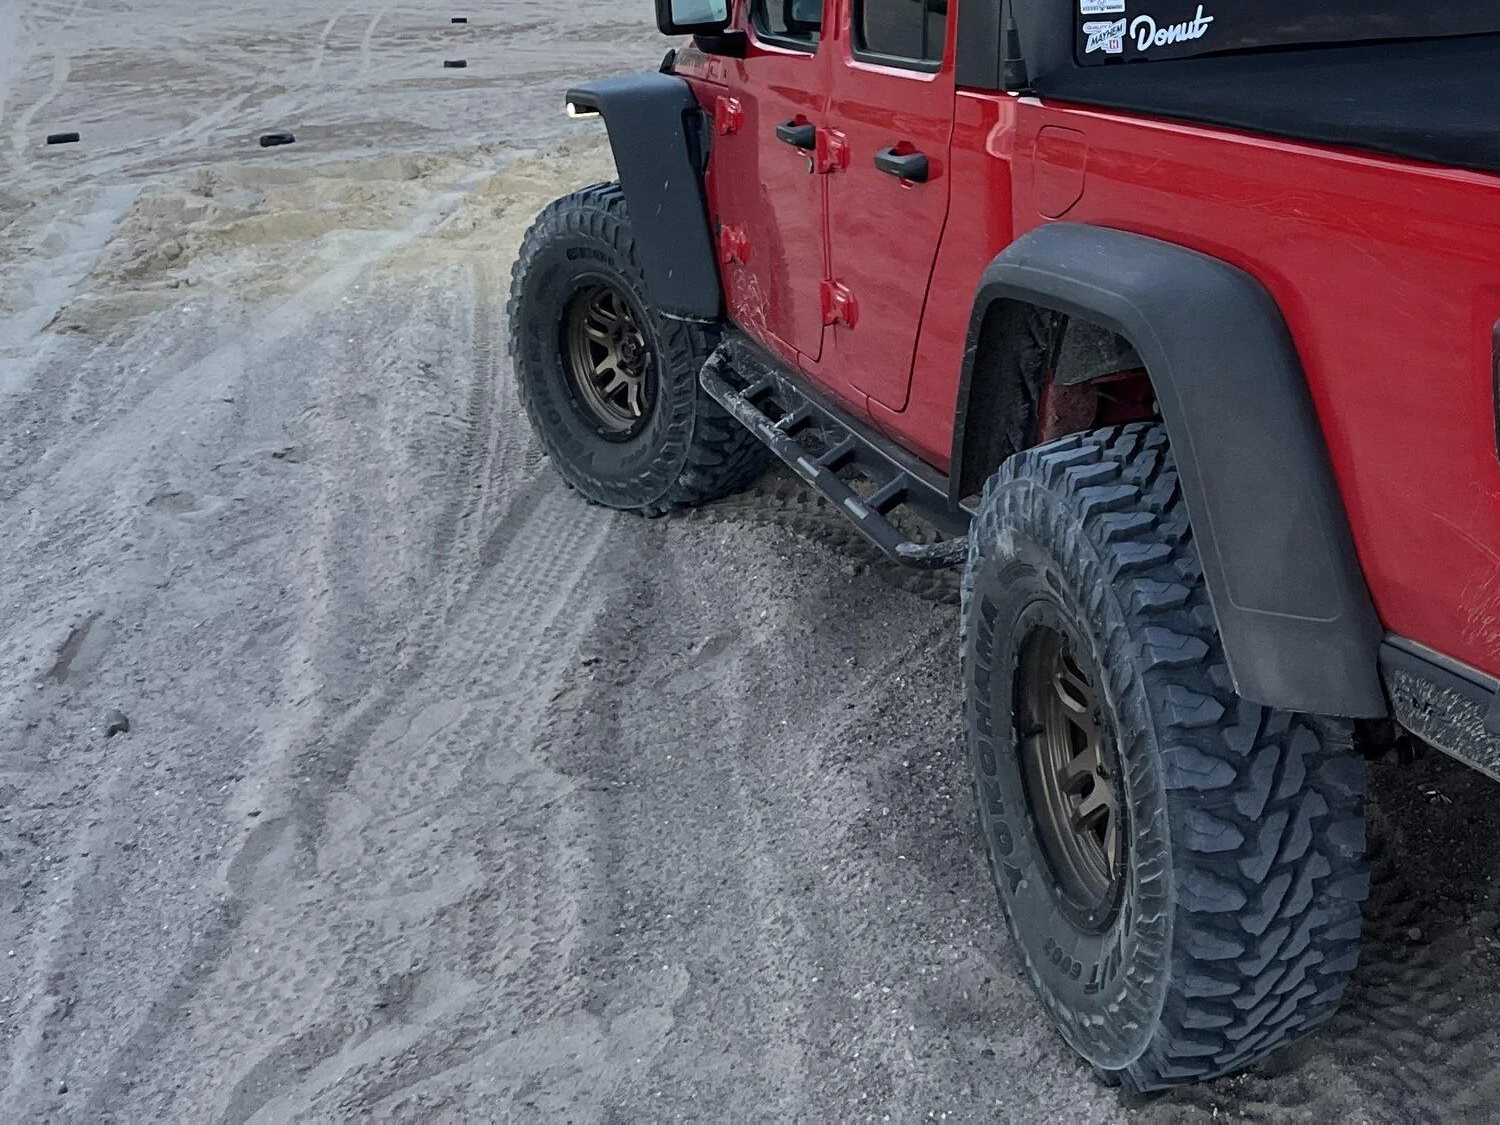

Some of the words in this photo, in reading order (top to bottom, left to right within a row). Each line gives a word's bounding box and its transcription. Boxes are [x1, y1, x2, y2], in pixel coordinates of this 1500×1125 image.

[1090, 23, 1124, 47] MAYHEM
[1130, 5, 1214, 51] Donut
[974, 594, 1025, 897] YOKOHAMA
